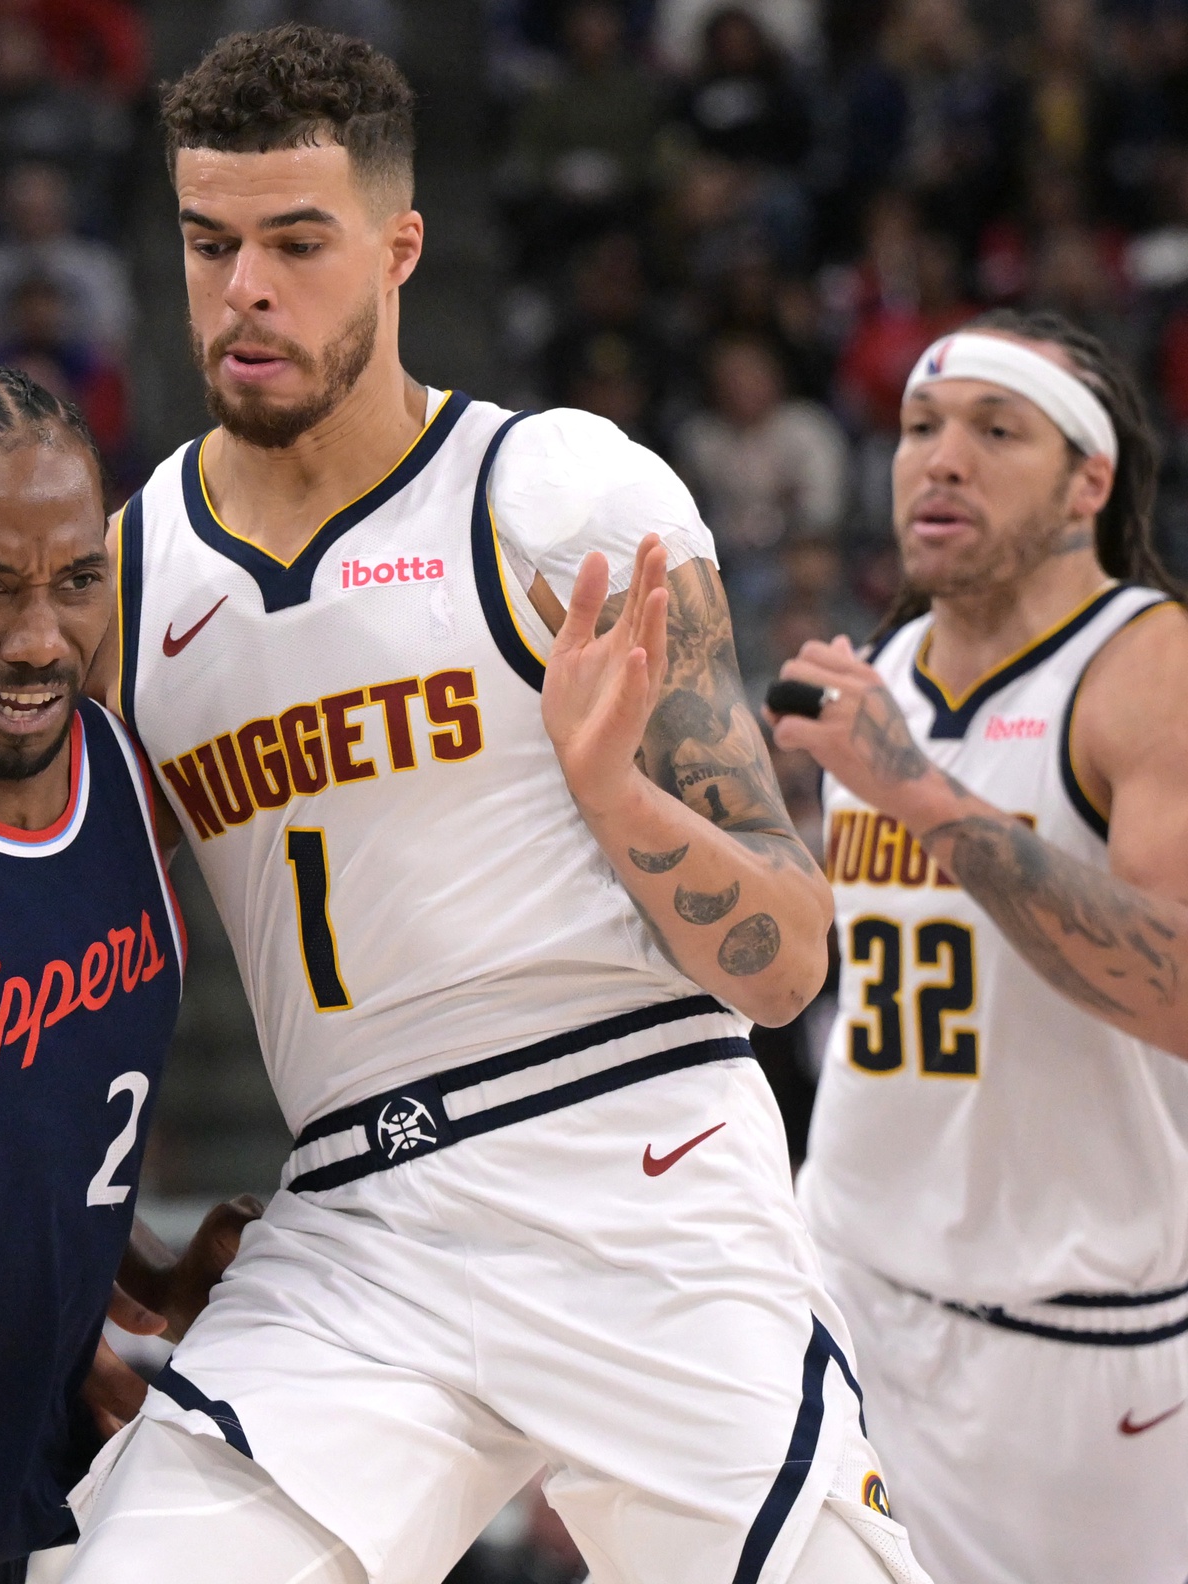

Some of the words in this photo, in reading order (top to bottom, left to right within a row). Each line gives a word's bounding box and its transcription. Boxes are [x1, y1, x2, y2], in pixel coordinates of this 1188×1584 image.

[341, 556, 445, 589] ibotta
[160, 667, 485, 842] NUGGETS
[285, 825, 354, 1014] 1
[847, 913, 980, 1081] 32
[86, 1070, 150, 1208] 2
